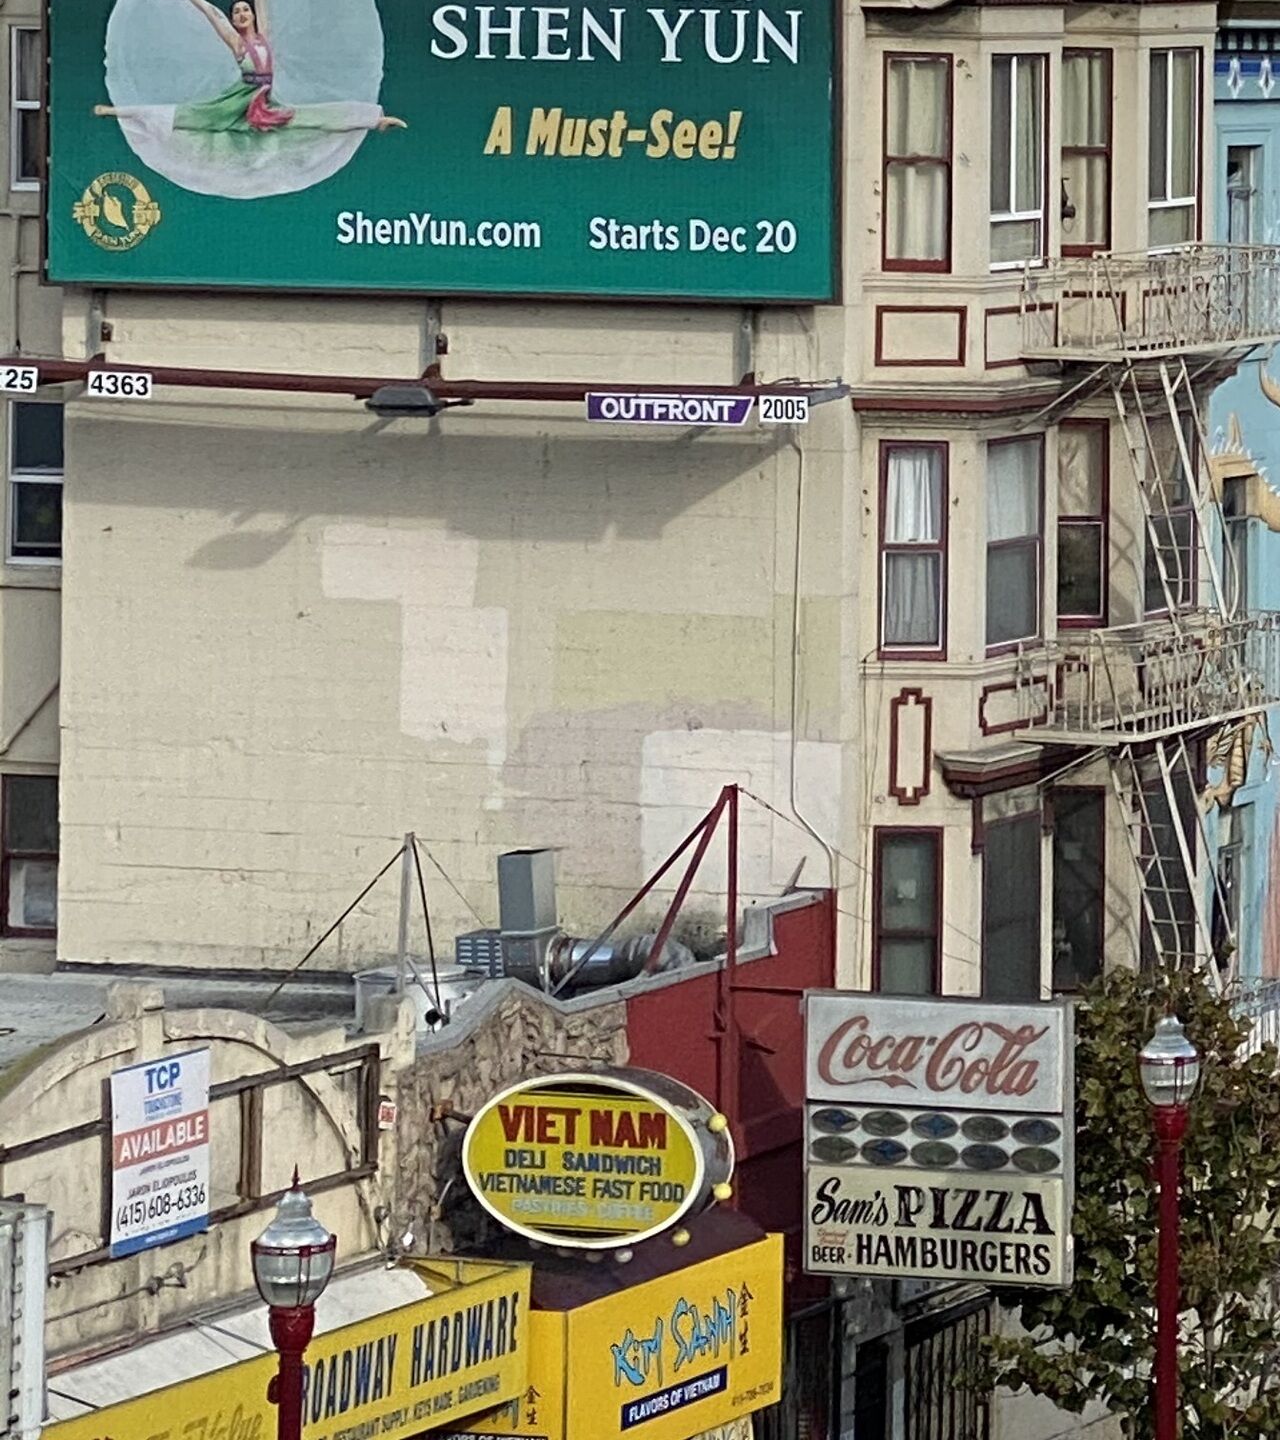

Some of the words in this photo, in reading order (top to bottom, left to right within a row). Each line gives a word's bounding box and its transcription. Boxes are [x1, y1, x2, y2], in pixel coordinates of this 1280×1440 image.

[430, 5, 626, 62] SHEN
[647, 8, 803, 65] YUN
[483, 106, 512, 155] A
[526, 107, 743, 160] Must-See!
[336, 210, 542, 249] ShenYun.com
[589, 216, 681, 252] Starts
[688, 218, 748, 253] Dec
[755, 220, 798, 253] 20
[0, 368, 35, 390] 25
[90, 374, 149, 396] 4363
[600, 397, 735, 422] OUTFRONT
[762, 398, 806, 420] 2005
[144, 1062, 181, 1094] TCP
[818, 1016, 1050, 1097] Coca-Cola
[120, 1116, 205, 1162] AVAILABLE
[497, 1105, 582, 1145] VIET
[589, 1110, 668, 1150] NAM
[504, 1149, 546, 1169] DELI
[562, 1151, 662, 1176] SANDWICH
[116, 1200, 147, 1231] (415)
[148, 1183, 206, 1219] 608-6336
[479, 1172, 586, 1196] VIETNAMESE
[592, 1178, 636, 1200] FAST
[639, 1180, 685, 1203] FOOD
[811, 1176, 889, 1226] Sam's
[893, 1184, 1056, 1236] PIZZA
[812, 1244, 845, 1264] BEER
[856, 1233, 1051, 1276] HAMBURGERS
[301, 1333, 398, 1427] ROADWAY
[410, 1291, 519, 1388] HARDWARE
[629, 1394, 670, 1423] FLAVORS
[670, 1389, 683, 1405] OF
[684, 1372, 721, 1399] VIETNAM
